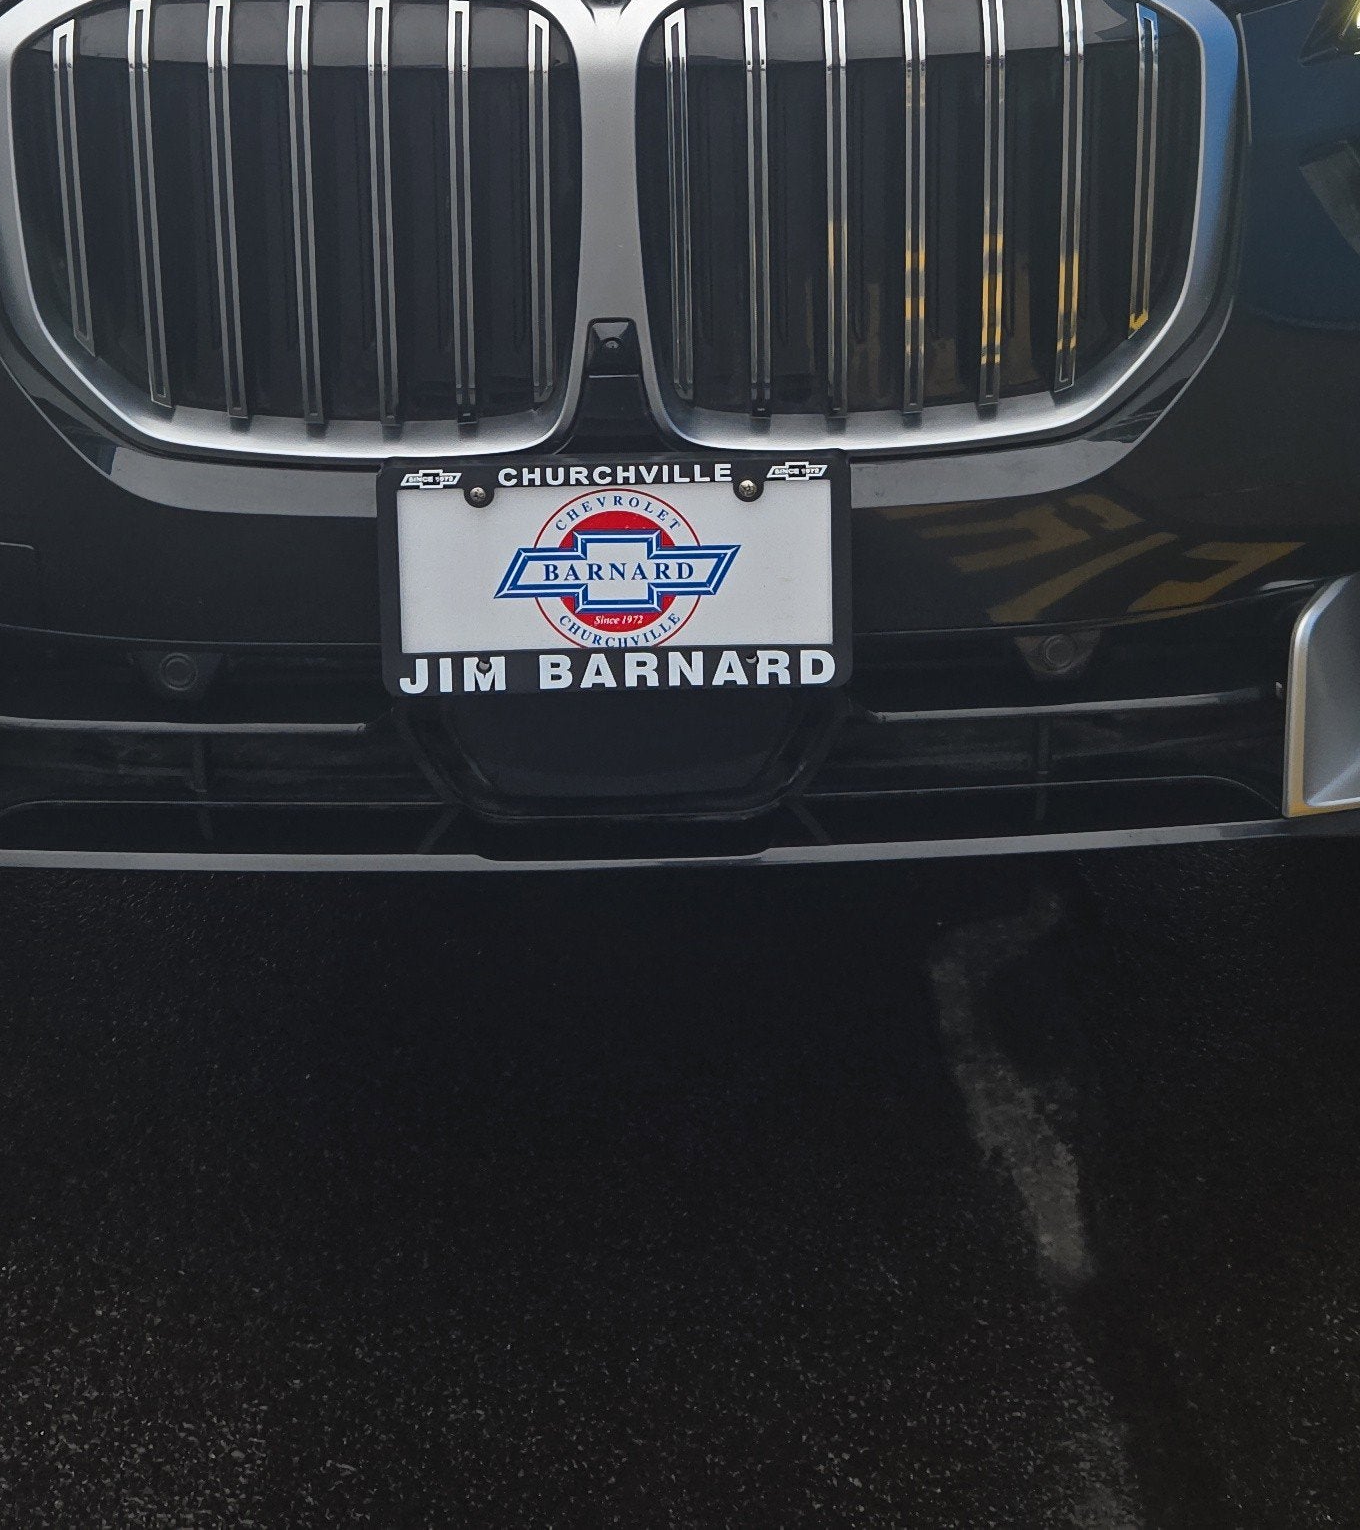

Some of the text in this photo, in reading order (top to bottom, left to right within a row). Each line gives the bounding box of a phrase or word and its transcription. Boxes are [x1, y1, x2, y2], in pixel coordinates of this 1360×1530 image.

[498, 463, 733, 487] CHURCHVILLE
[555, 495, 681, 531] CHEVROLET
[543, 562, 694, 581] BARNARD
[559, 612, 681, 647] CHURCHVILLE
[594, 614, 644, 625] Since 1972
[400, 649, 836, 695] JIM BARNARD
